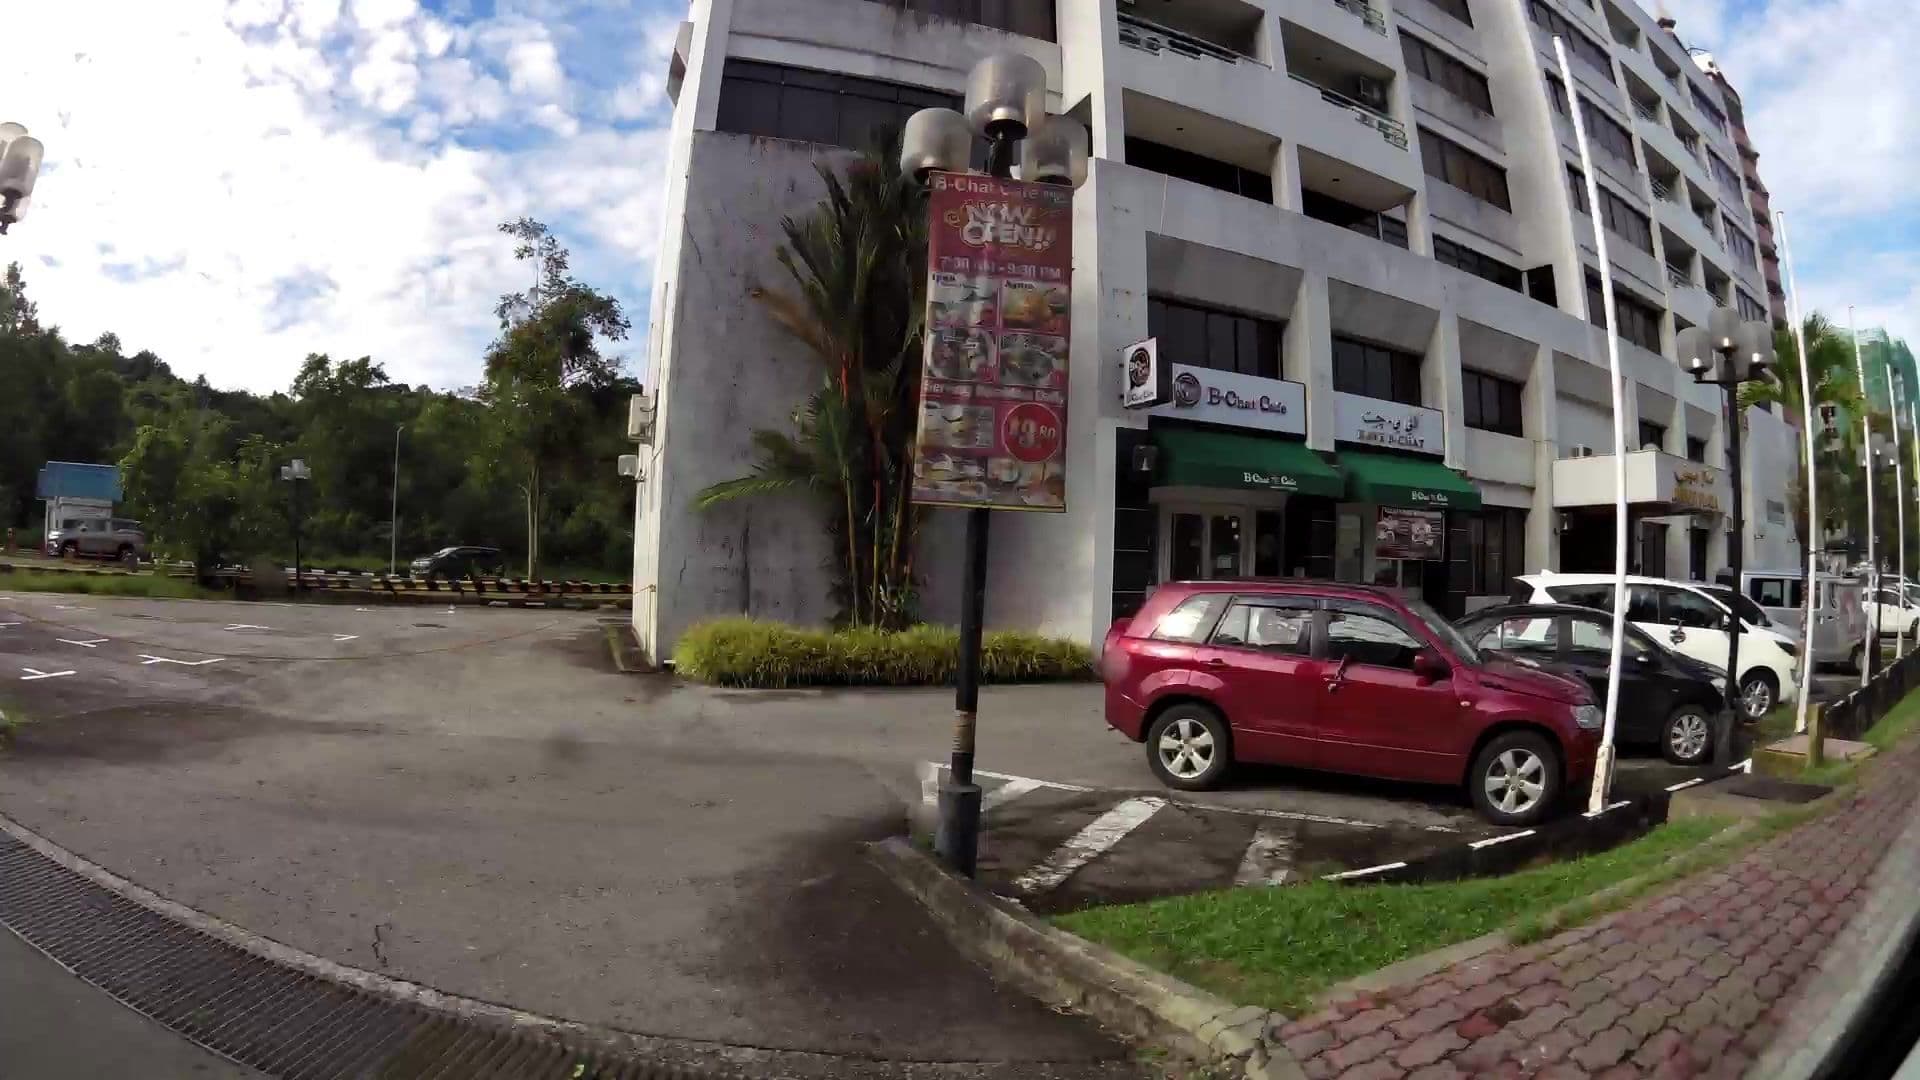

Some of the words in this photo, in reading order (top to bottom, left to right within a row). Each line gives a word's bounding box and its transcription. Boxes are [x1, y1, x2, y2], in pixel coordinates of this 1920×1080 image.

[935, 175, 993, 193] B-Chat
[1000, 181, 1038, 198] Cfe
[1207, 386, 1256, 410] B-Chat
[1259, 395, 1288, 414] Cafe
